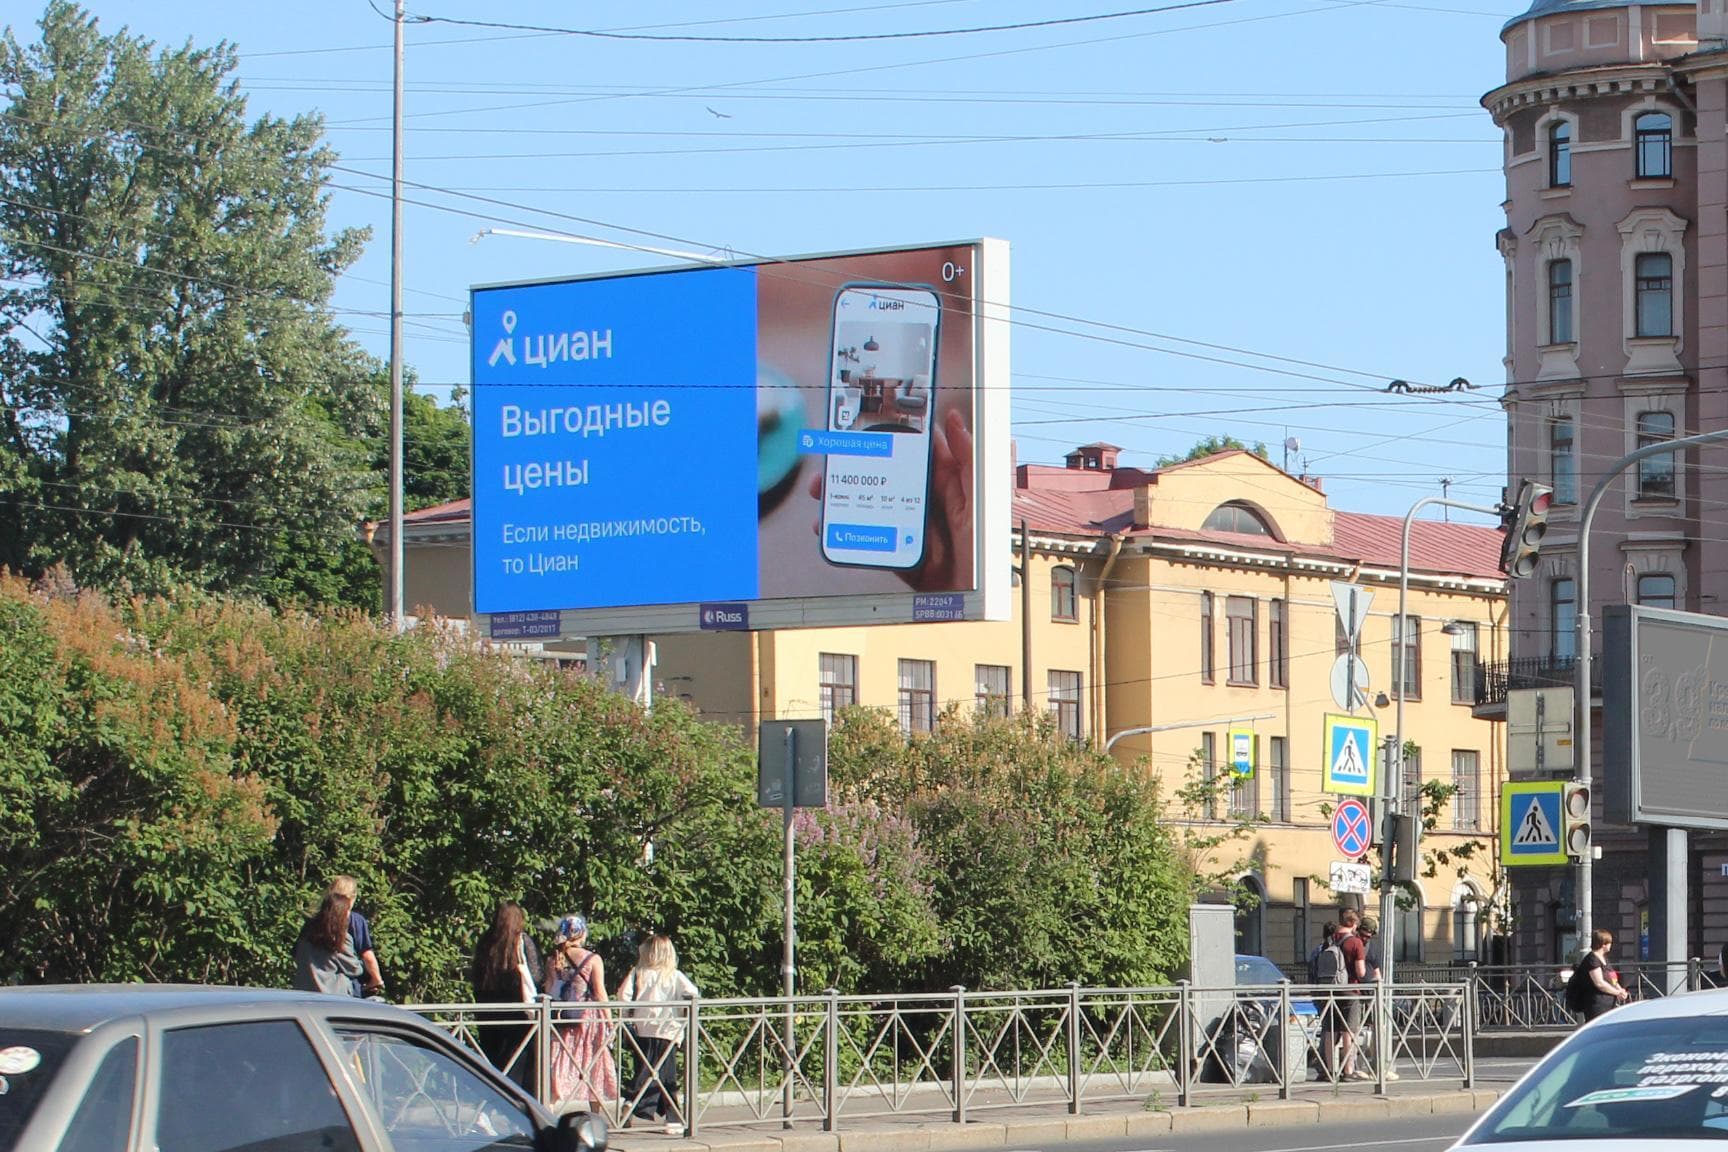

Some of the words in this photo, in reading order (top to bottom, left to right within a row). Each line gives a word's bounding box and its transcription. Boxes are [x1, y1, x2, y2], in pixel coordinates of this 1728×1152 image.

[942, 261, 965, 282] 0+
[878, 299, 905, 311] циан
[524, 328, 613, 369] циан
[501, 399, 672, 438] Выгодные
[818, 436, 862, 450] Хорошая
[503, 459, 590, 496] цены
[861, 476, 879, 486] 000
[503, 523, 549, 544] Если
[554, 516, 706, 543] недвижимость,
[845, 532, 889, 544] Позвонить
[503, 558, 524, 575] то
[529, 552, 579, 576] Циан
[715, 610, 742, 623] Russ
